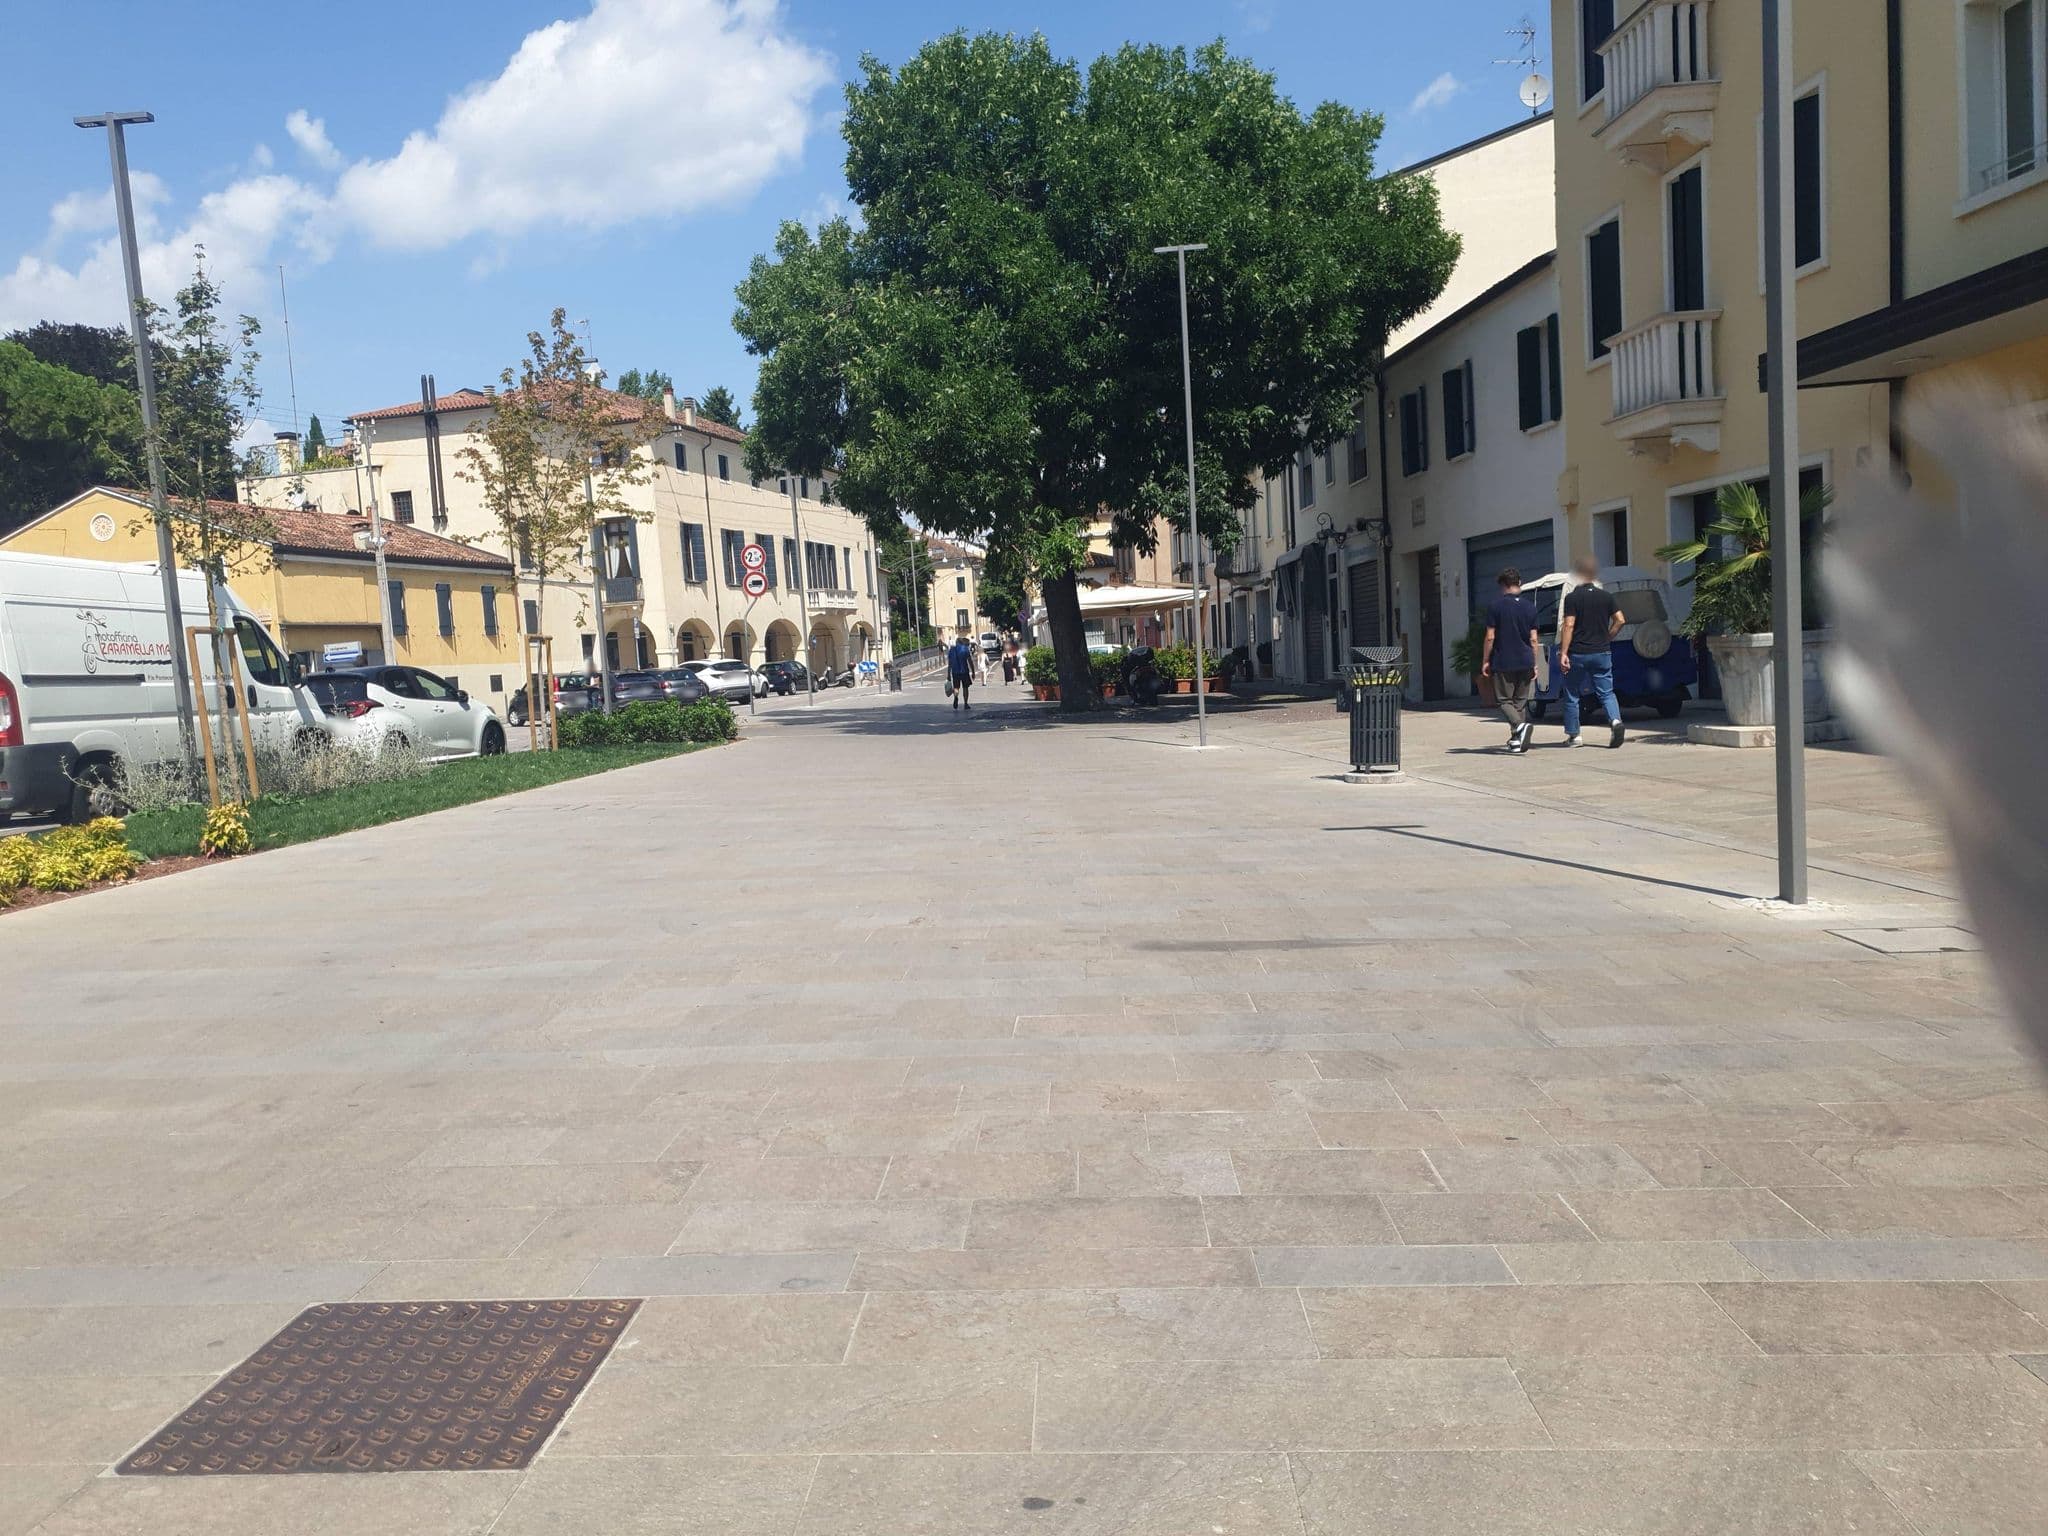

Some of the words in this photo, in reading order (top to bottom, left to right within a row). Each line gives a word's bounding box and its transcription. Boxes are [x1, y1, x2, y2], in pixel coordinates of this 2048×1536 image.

[95, 631, 138, 643] motofficina
[101, 643, 154, 656] ZARAMELLA
[156, 643, 171, 656] MA
